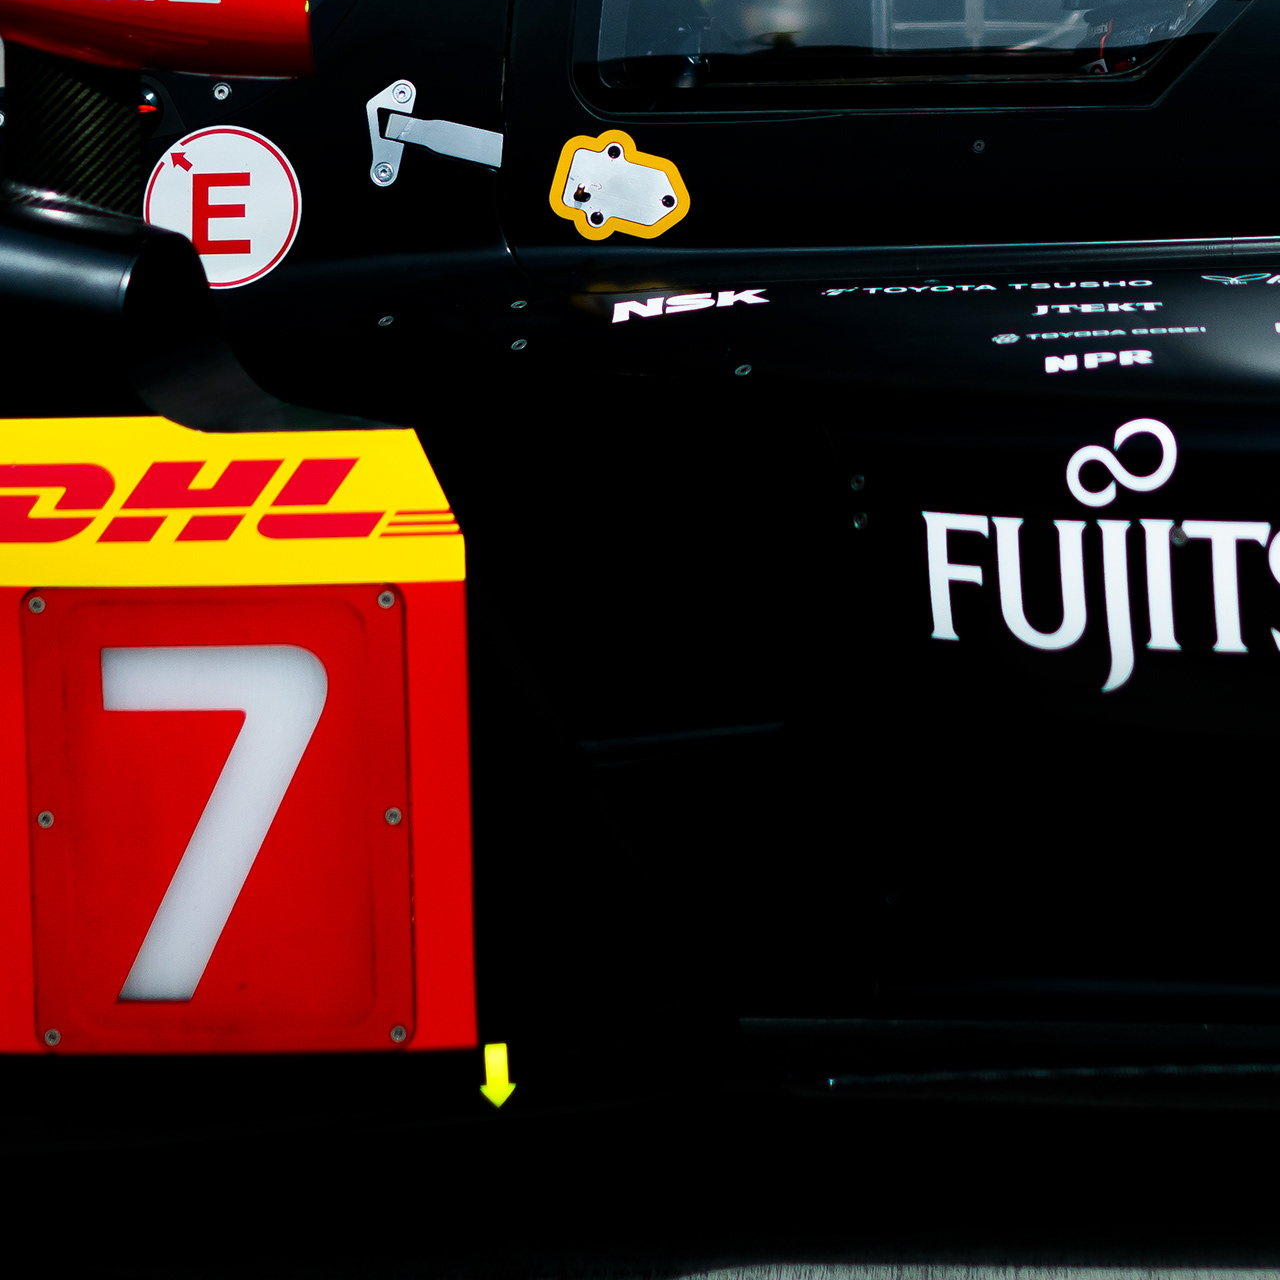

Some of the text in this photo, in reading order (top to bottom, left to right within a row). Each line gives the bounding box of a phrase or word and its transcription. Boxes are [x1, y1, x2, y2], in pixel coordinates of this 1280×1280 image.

[192, 172, 252, 255] E
[863, 279, 1153, 295] TOYOTA TSUSHO
[612, 288, 771, 324] NSK
[1032, 301, 1163, 316] JTEKT
[1044, 349, 1154, 374] NPR
[101, 643, 329, 1003] 7
